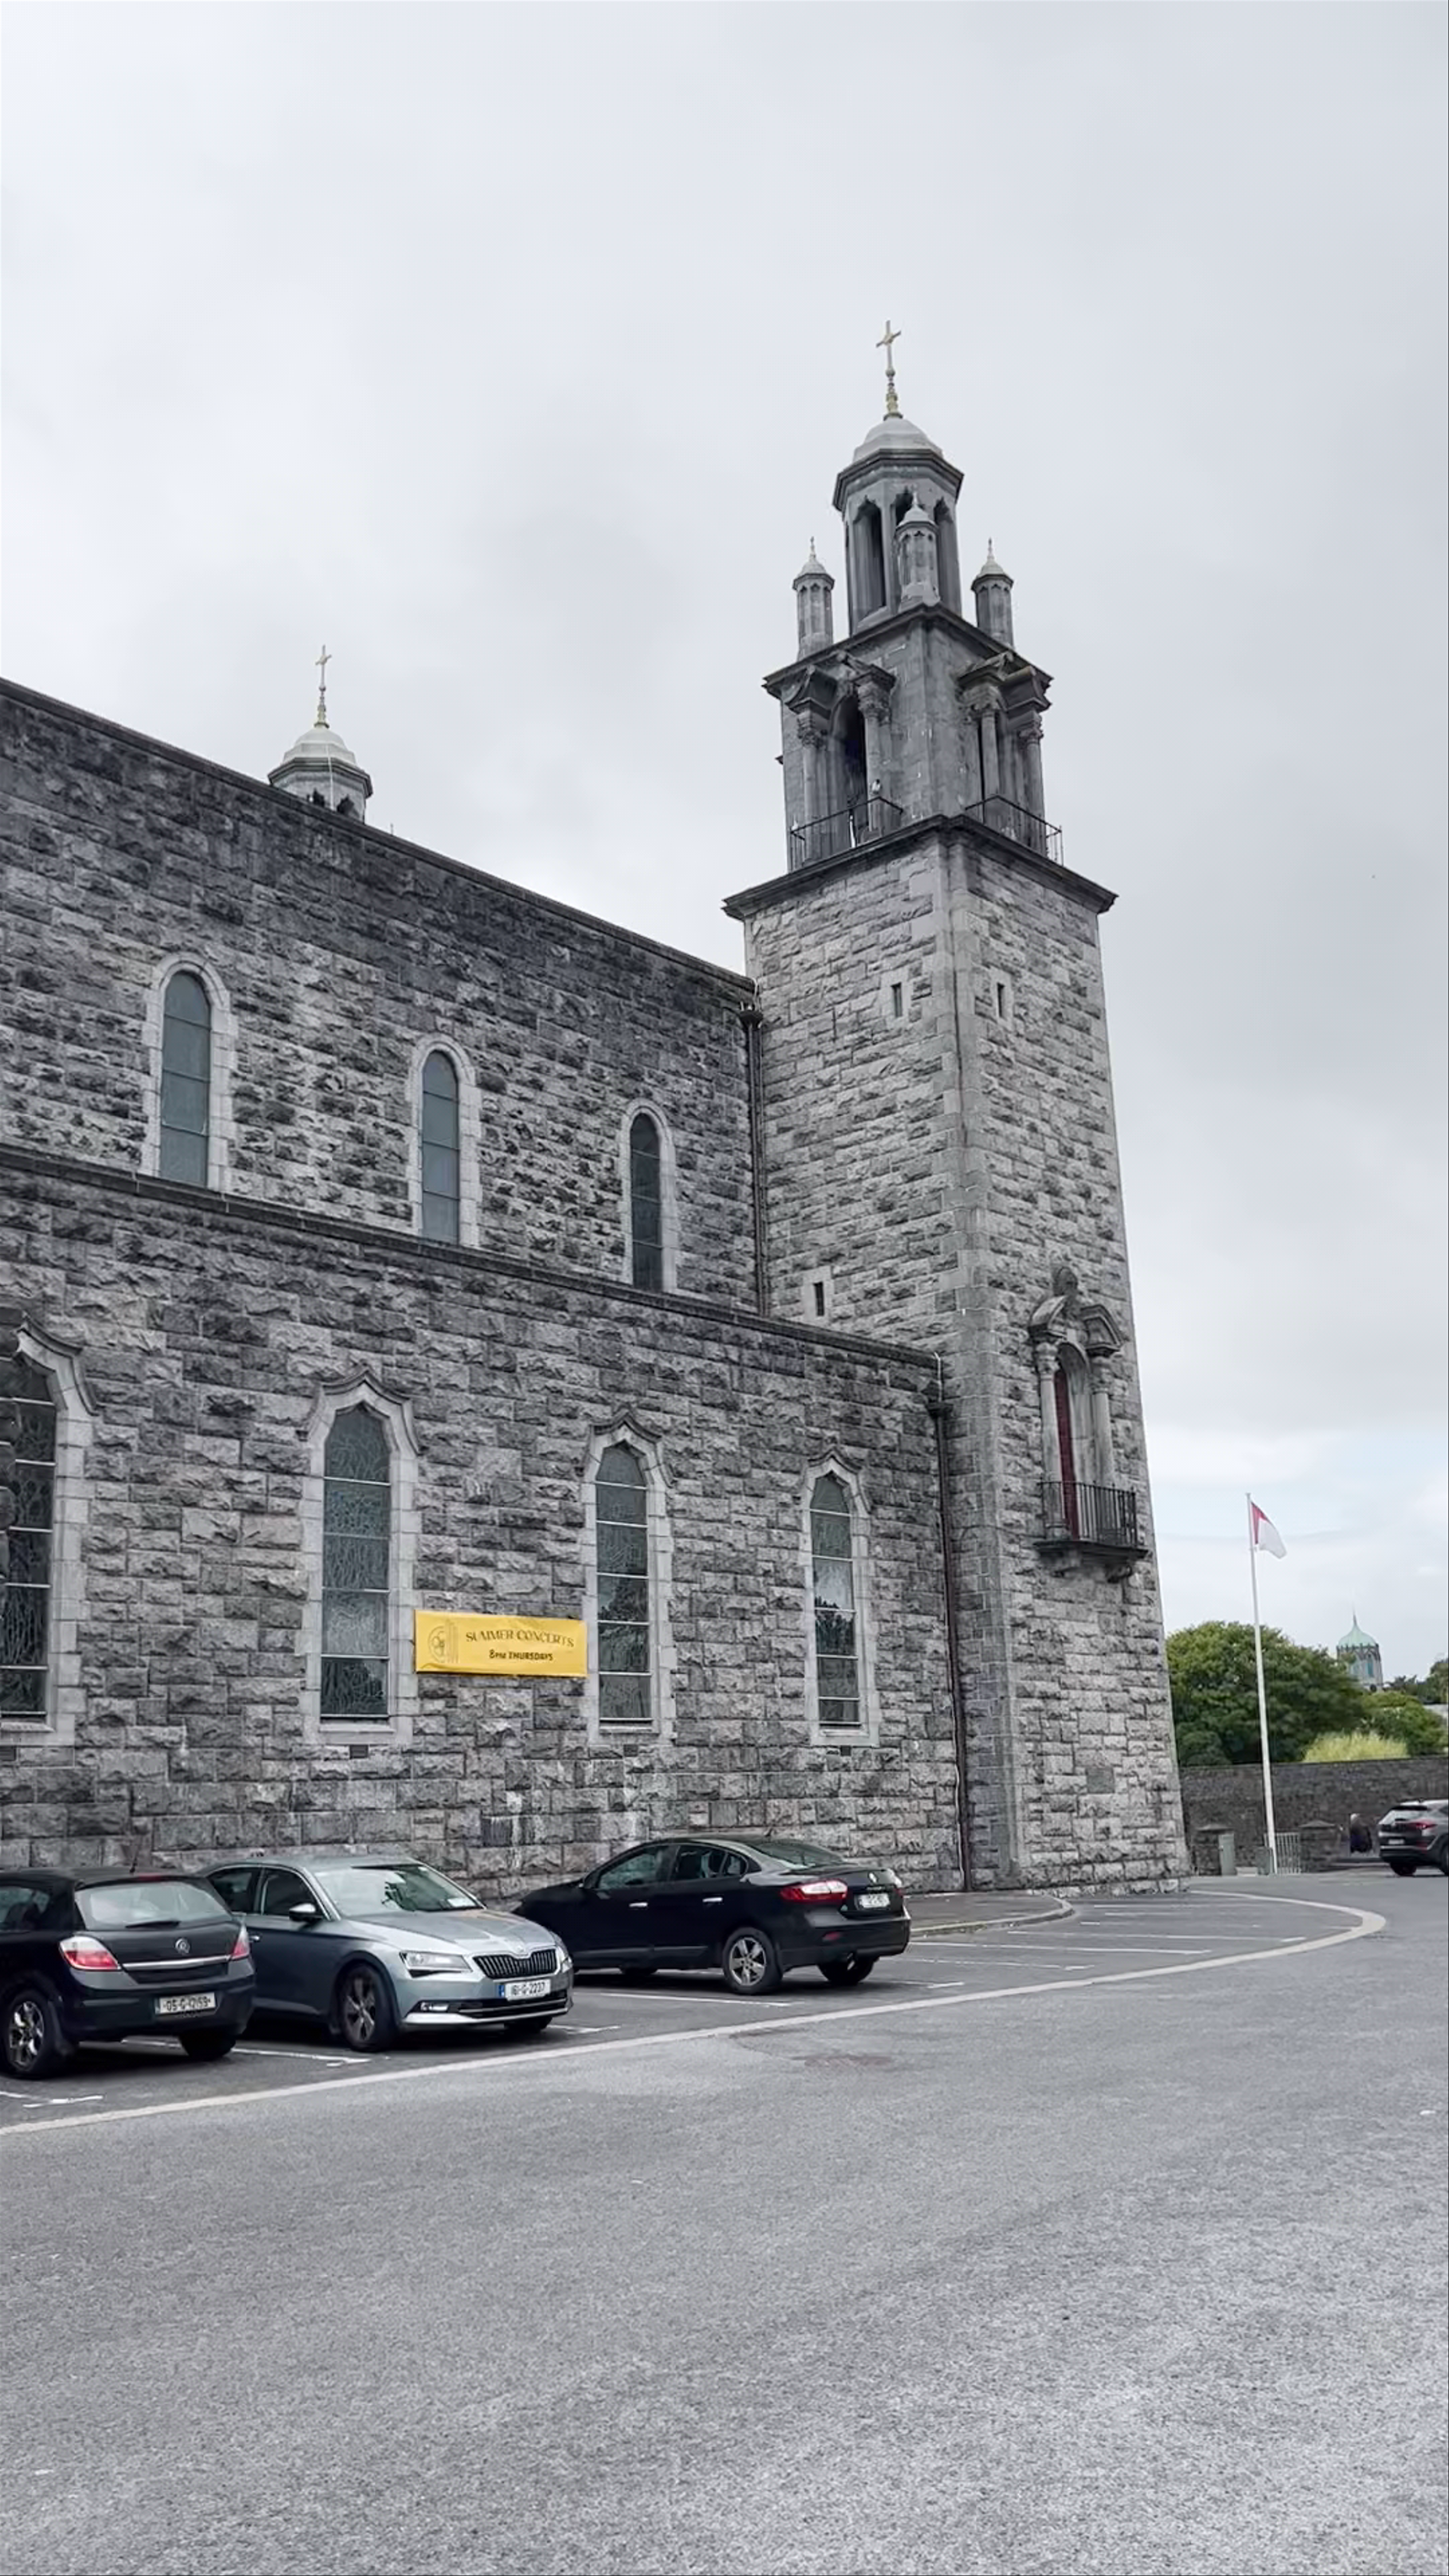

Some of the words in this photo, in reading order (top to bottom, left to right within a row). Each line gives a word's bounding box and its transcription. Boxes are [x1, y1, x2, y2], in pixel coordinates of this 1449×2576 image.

[466, 1630, 514, 1641] SUMMER
[517, 1630, 574, 1647] CONCERTS
[508, 1651, 553, 1661] THURSDAYS
